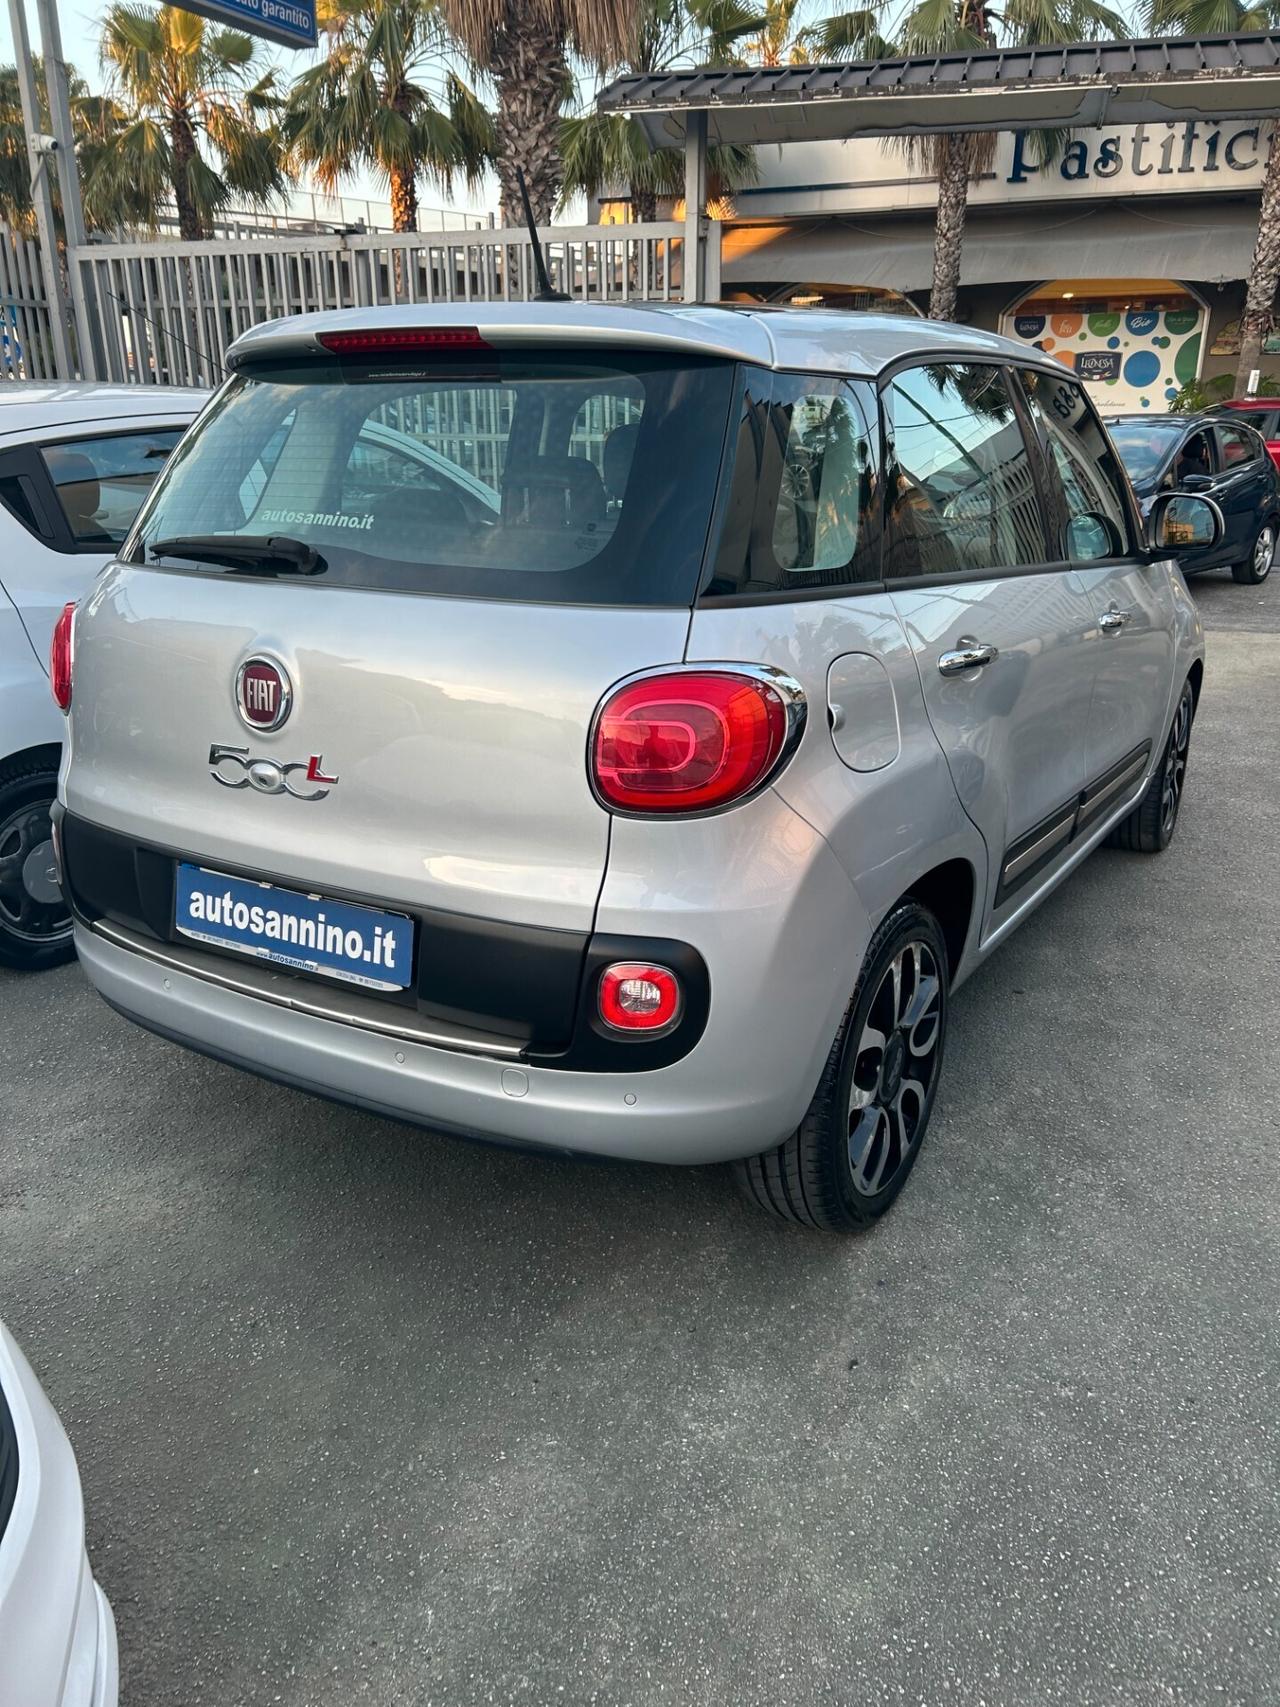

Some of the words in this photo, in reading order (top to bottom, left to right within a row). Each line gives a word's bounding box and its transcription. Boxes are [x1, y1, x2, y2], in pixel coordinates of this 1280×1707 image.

[261, 0, 310, 29] garantito
[1130, 316, 1153, 329] Bio
[1080, 357, 1114, 369] LEONESSA
[262, 508, 375, 529] autosannino.it
[246, 677, 277, 712] FIAT
[208, 743, 339, 801] 500L
[189, 890, 397, 968] autosannino.it
